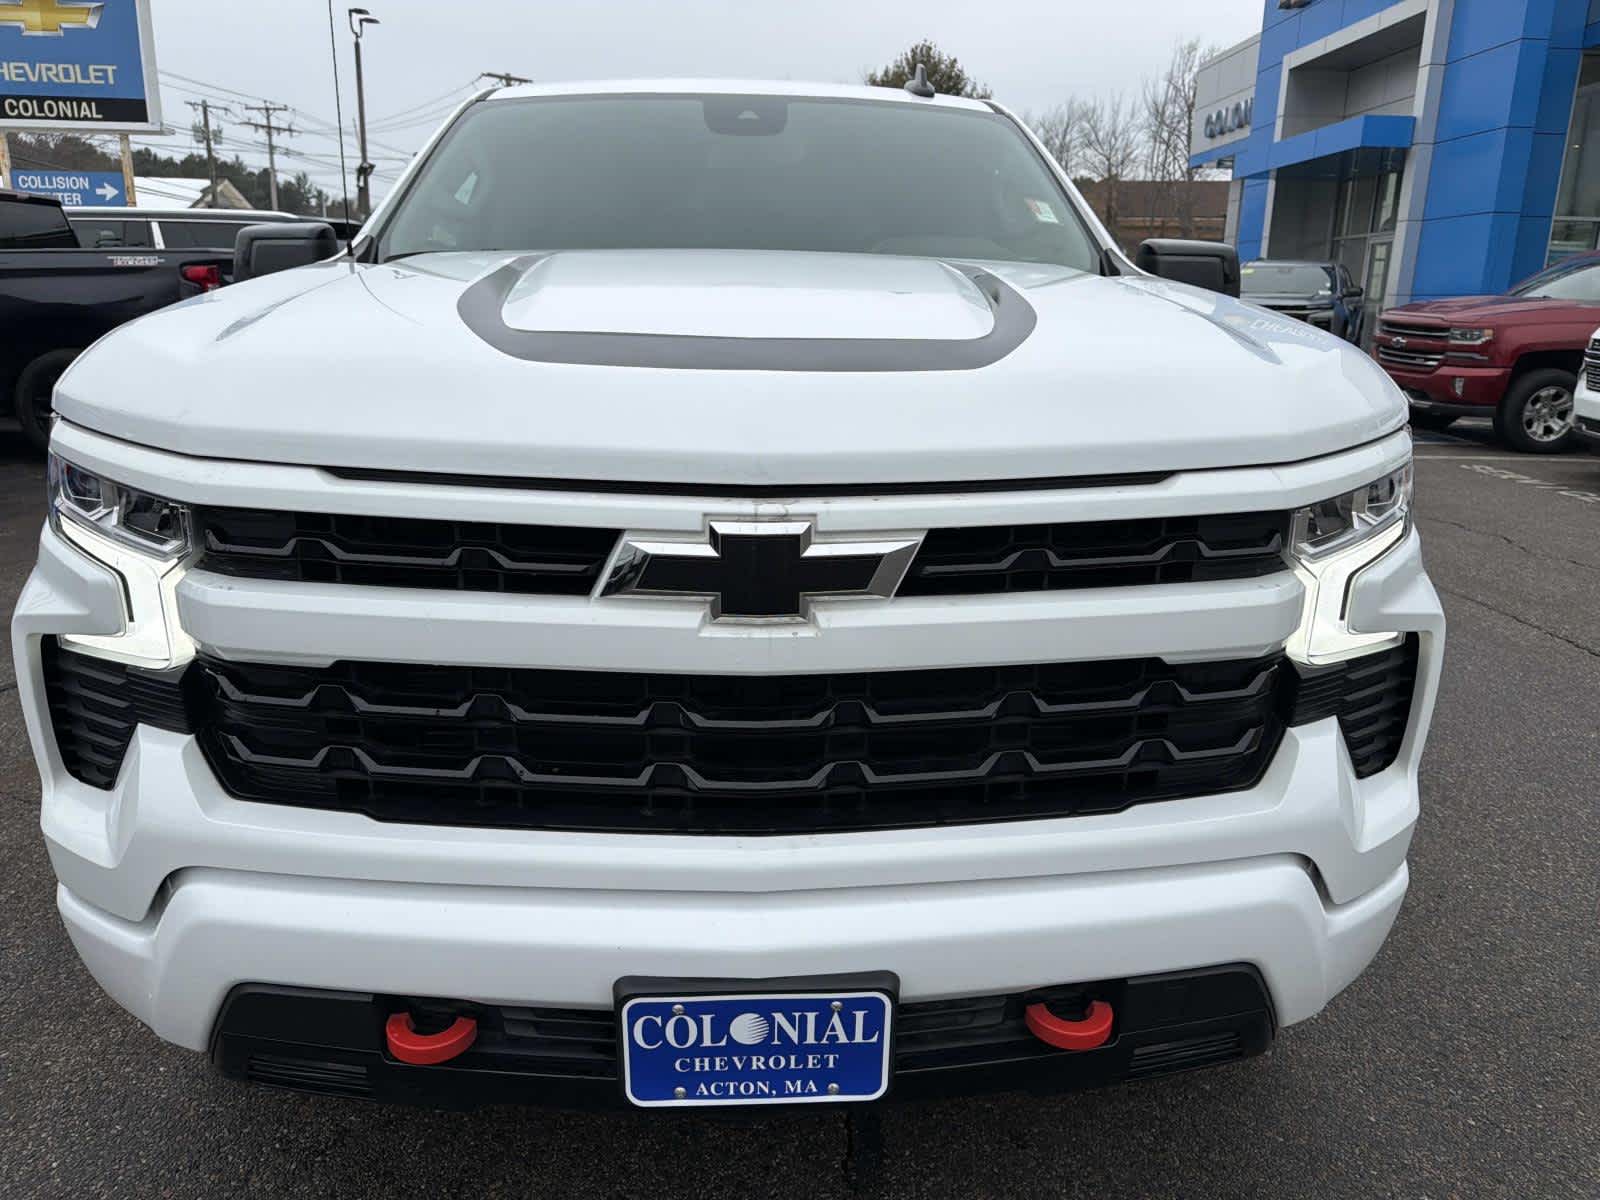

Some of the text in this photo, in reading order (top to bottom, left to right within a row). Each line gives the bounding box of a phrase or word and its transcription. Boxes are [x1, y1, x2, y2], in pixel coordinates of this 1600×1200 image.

[0, 61, 118, 85] HEVROLET
[4, 98, 103, 119] COLONIAL
[18, 175, 90, 190] COLLISION
[633, 1010, 880, 1049] COLONIAL
[674, 1053, 840, 1073] CHEVROLET
[696, 1079, 819, 1097] ACTON, MA
